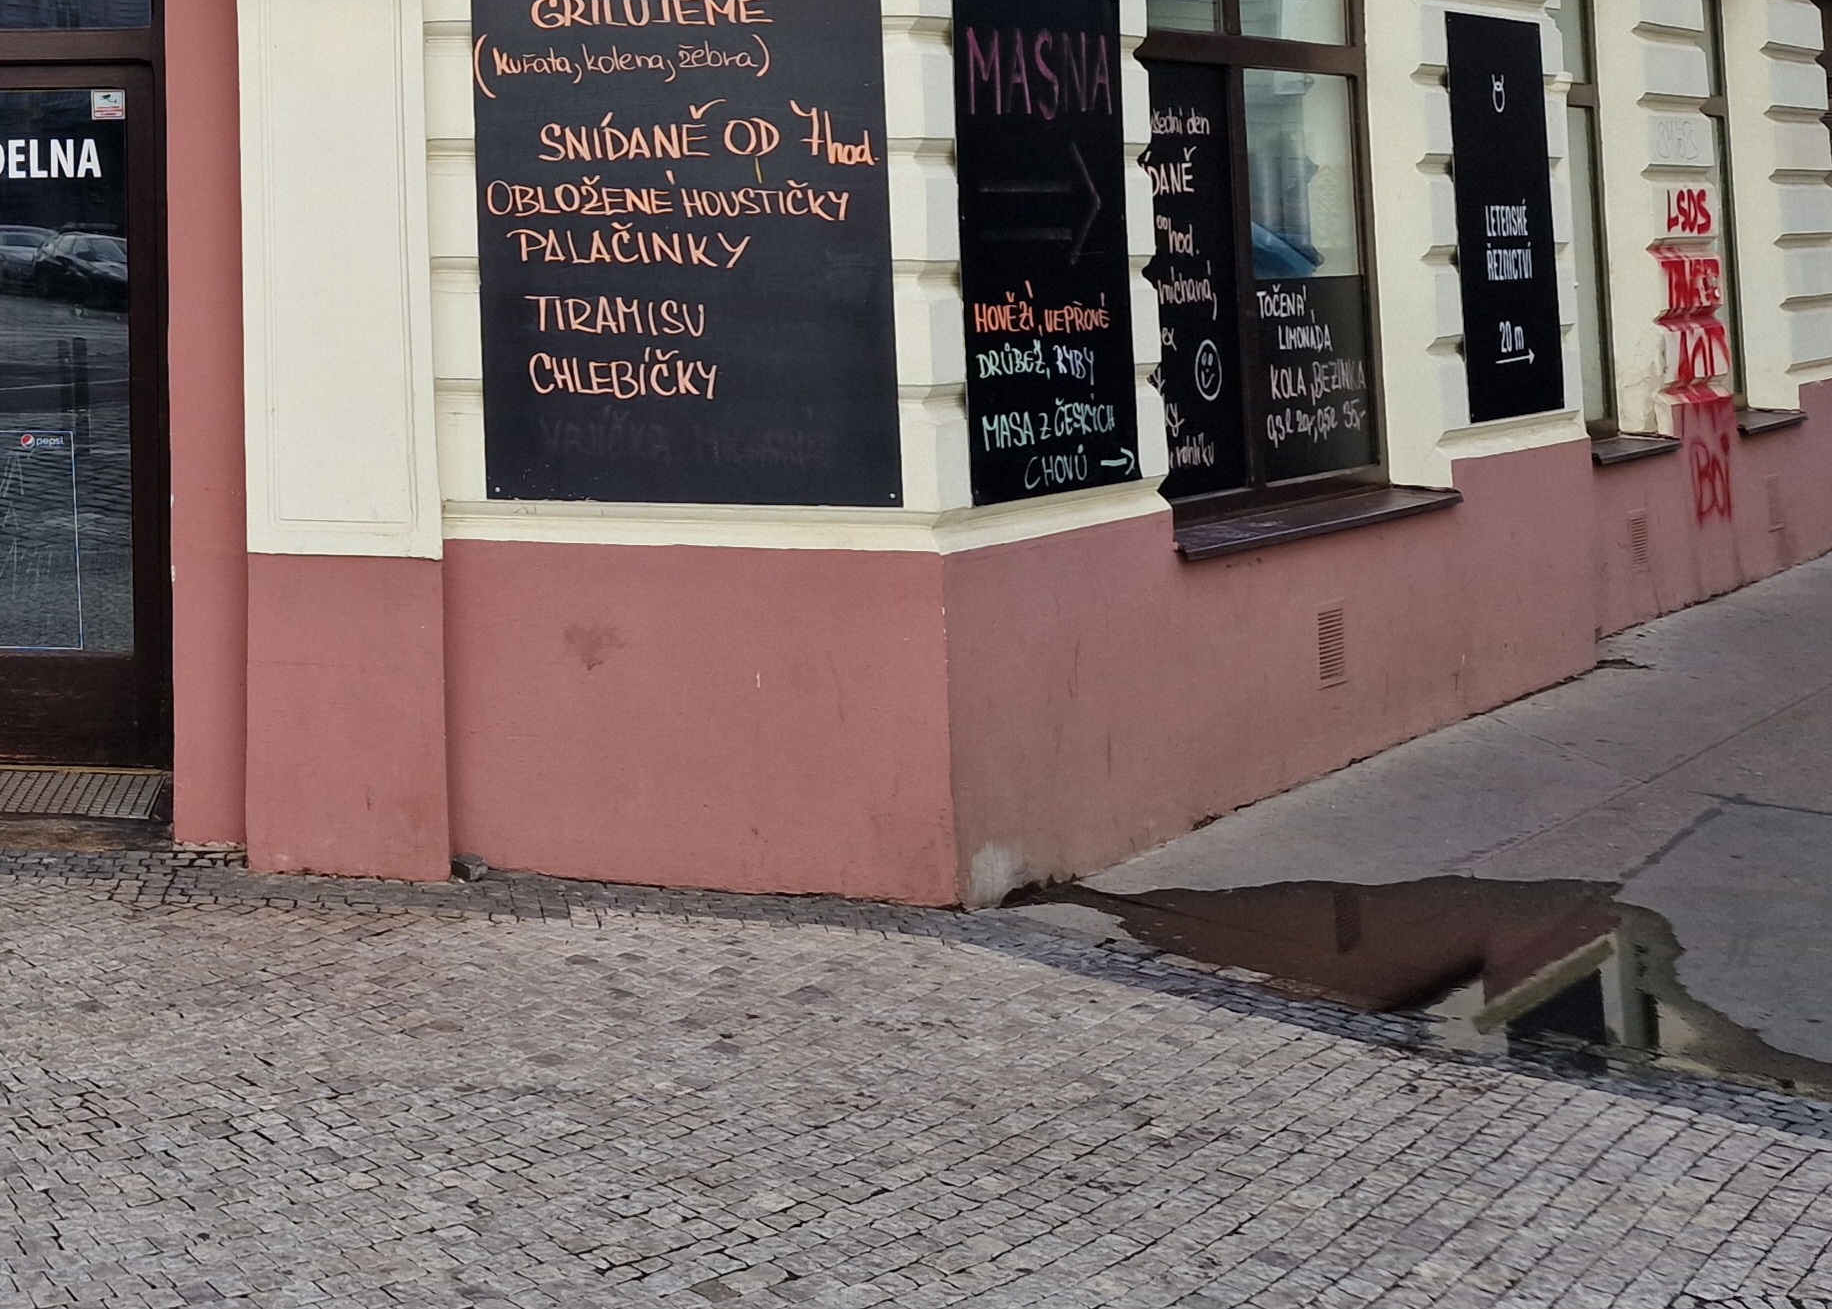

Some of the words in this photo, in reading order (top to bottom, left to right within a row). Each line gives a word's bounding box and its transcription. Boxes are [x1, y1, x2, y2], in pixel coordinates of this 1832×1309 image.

[966, 26, 1113, 120] MASNA
[538, 99, 727, 161] SNÍDANĚ
[724, 117, 781, 157] OD
[487, 169, 674, 217] OBLOŽENÉ
[506, 223, 753, 269] PALAČINKY
[1168, 217, 1200, 256] hod.
[524, 295, 707, 338] TIRAMISU
[1499, 320, 1513, 353] 20
[1514, 326, 1525, 351] m
[528, 347, 719, 400] CHLEBÍČKY
[1053, 345, 1094, 386] RYBY
[36, 436, 65, 447] pepsi
[982, 412, 1035, 452] MASA
[1024, 444, 1088, 490] CHOVŮ
